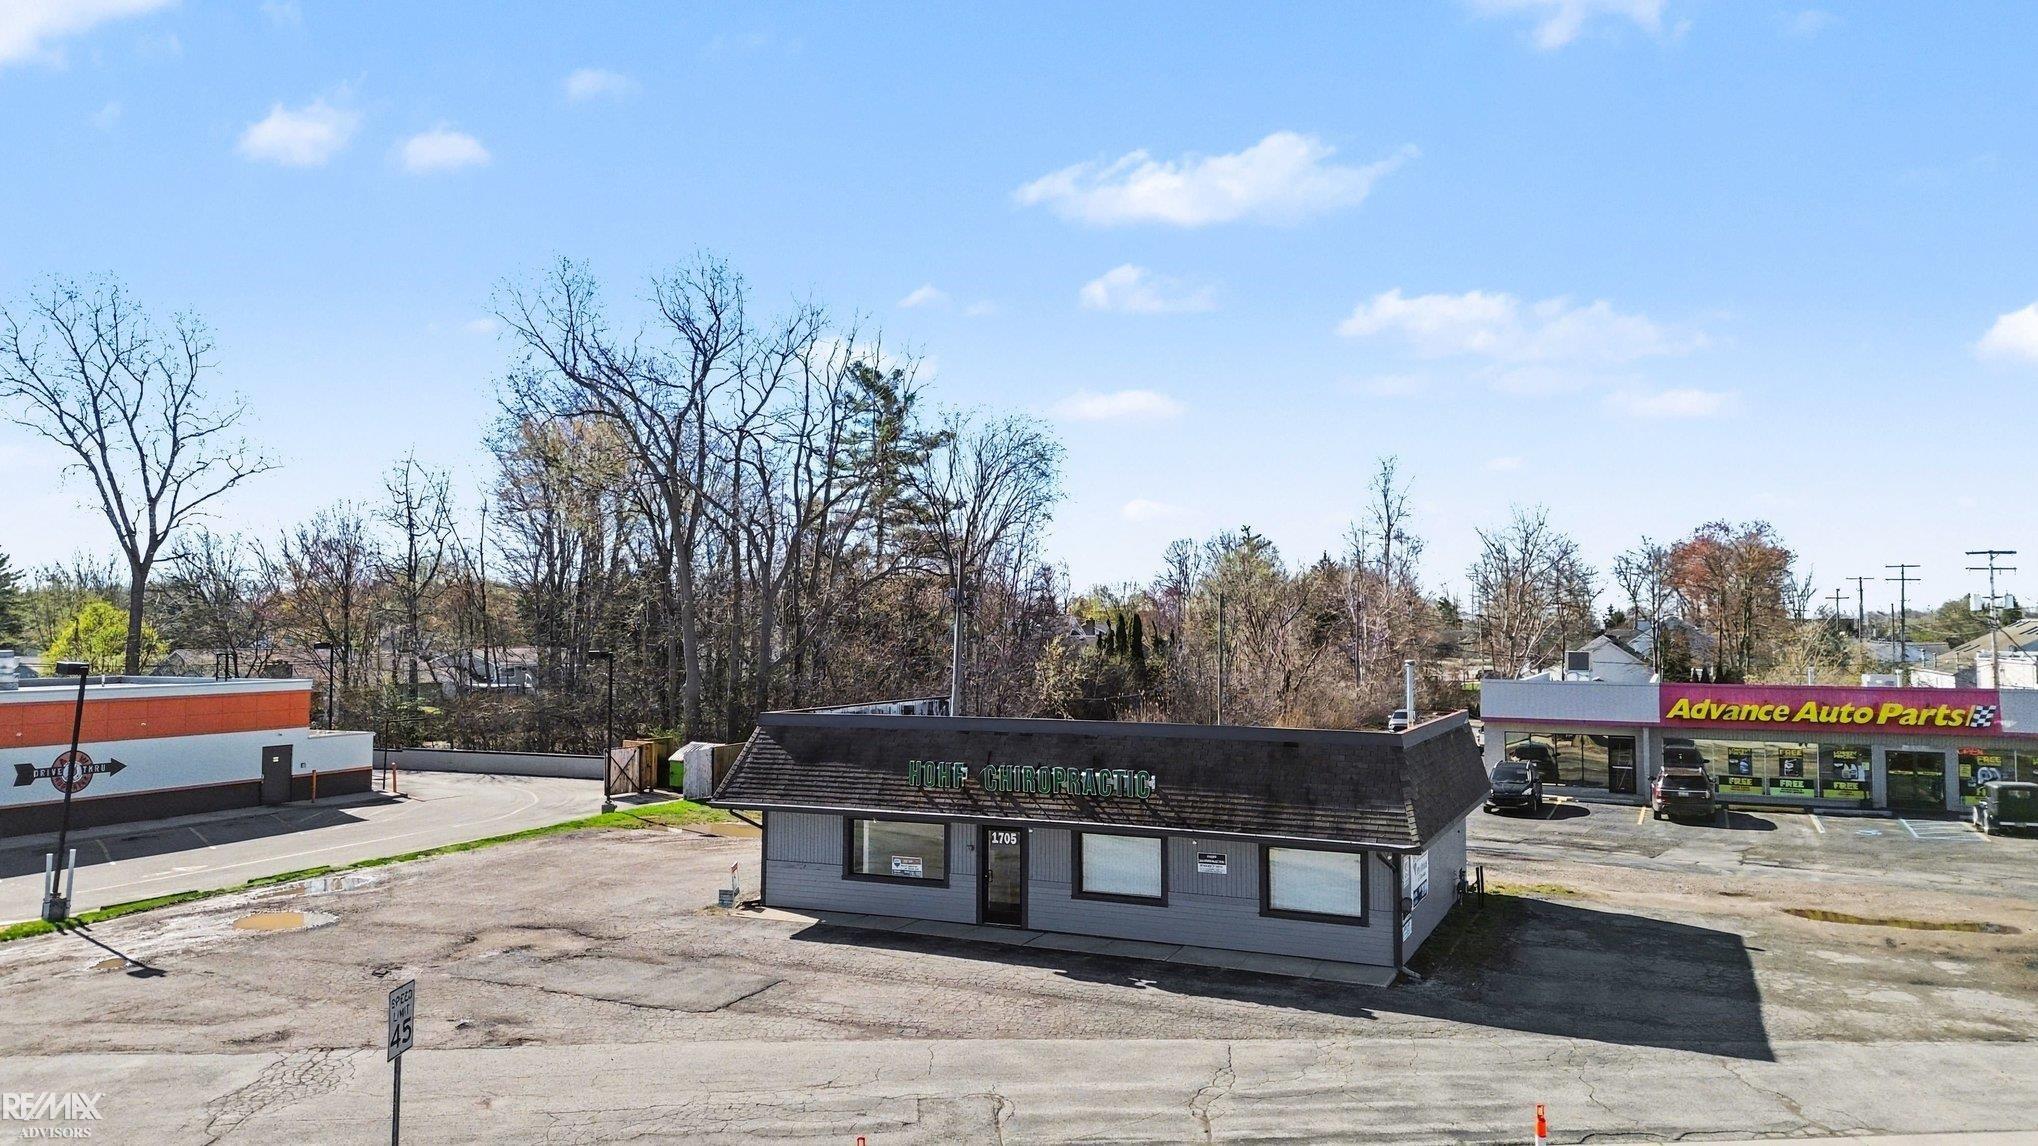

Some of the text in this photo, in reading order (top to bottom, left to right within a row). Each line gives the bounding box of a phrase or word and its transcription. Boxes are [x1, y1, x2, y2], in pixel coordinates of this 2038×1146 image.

[1666, 698, 1964, 727] Advance Auto Parts
[33, 764, 106, 778] DRIVE THRU
[984, 764, 1152, 799] CHIROPRACTIC
[1728, 777, 1753, 786] FREE
[1779, 779, 1805, 788] FREE
[1833, 781, 1859, 790] FREE
[991, 831, 1017, 845] 1705
[391, 990, 412, 1009] SPEED
[393, 1003, 411, 1022] LIMIT
[390, 1016, 412, 1049] 45
